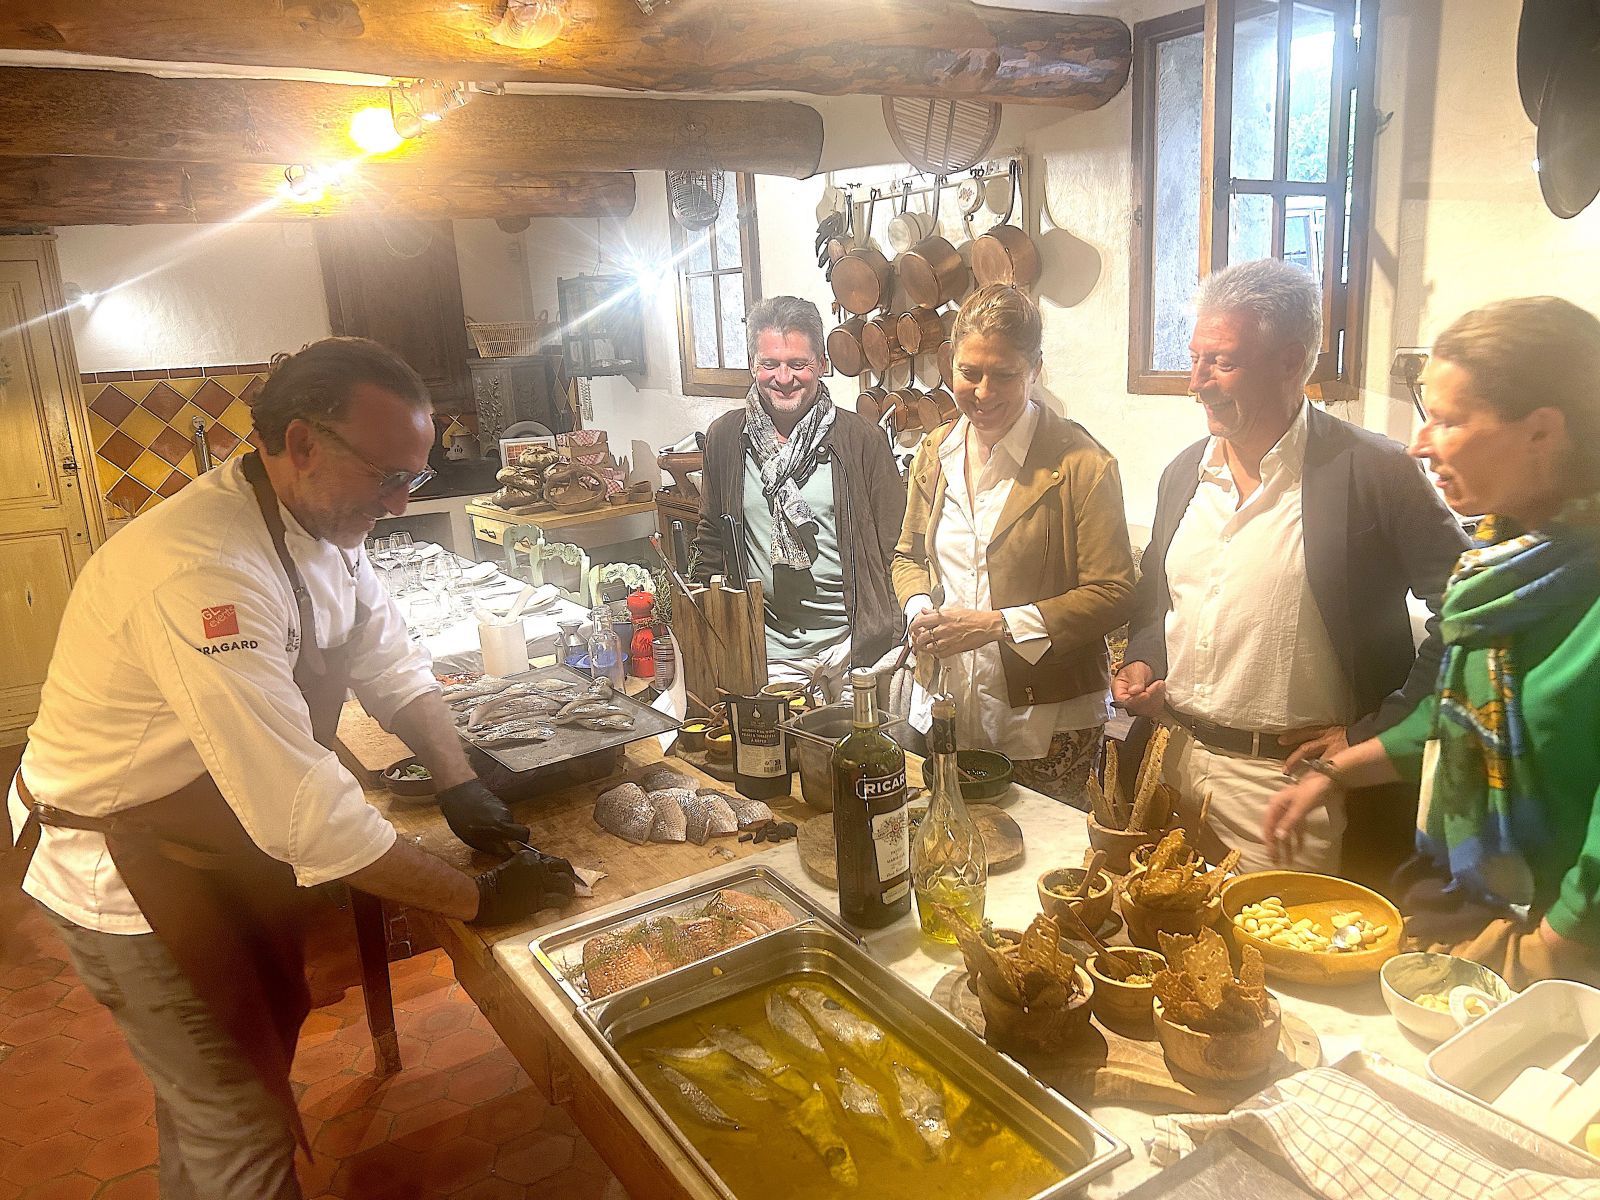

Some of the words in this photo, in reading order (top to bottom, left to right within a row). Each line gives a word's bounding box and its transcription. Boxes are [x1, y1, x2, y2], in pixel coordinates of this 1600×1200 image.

[202, 607, 221, 621] GL
[209, 608, 235, 628] events
[196, 640, 258, 656] RAGARD
[865, 773, 905, 795] RICAR
